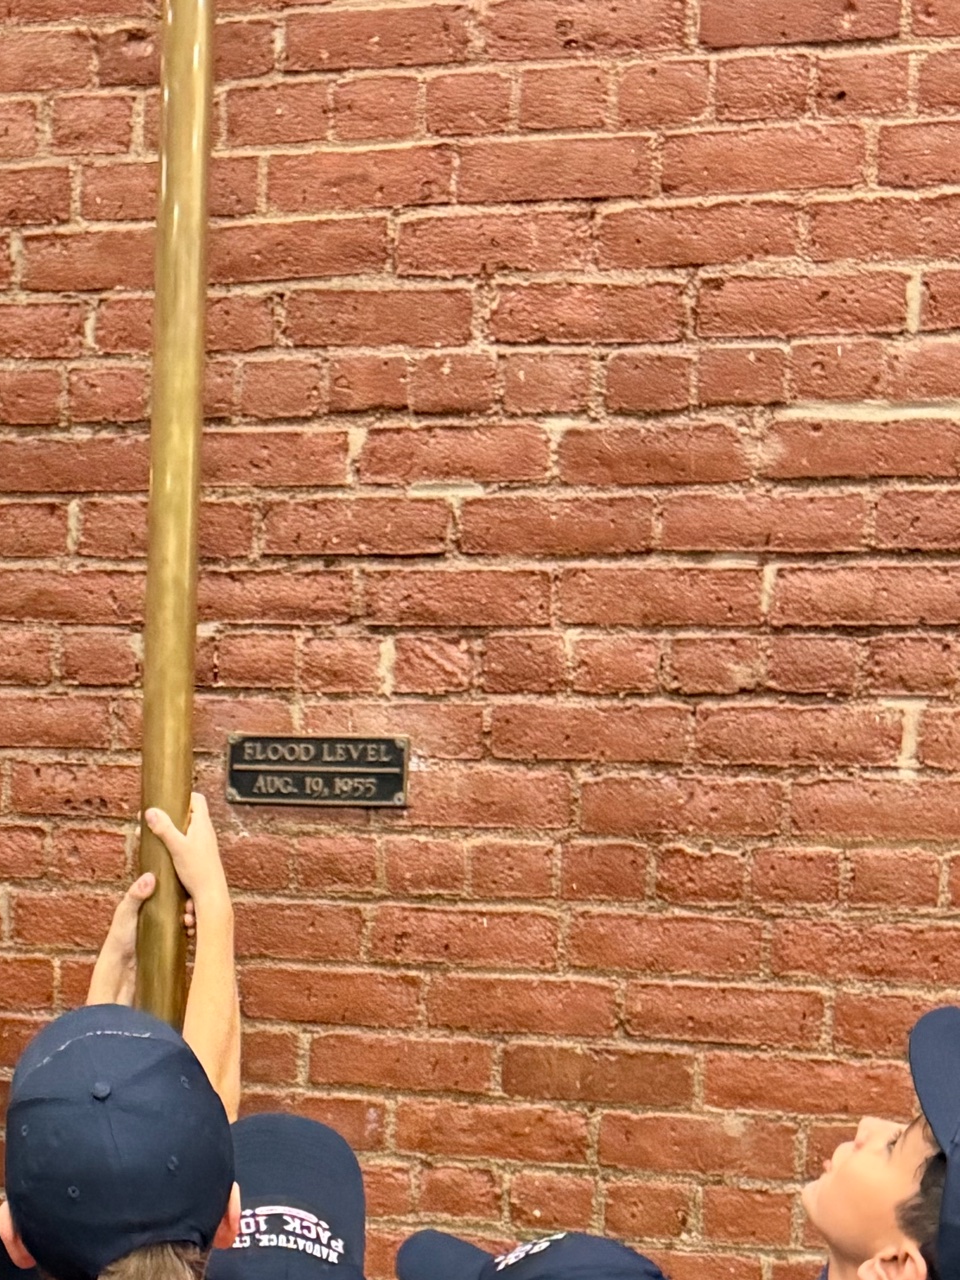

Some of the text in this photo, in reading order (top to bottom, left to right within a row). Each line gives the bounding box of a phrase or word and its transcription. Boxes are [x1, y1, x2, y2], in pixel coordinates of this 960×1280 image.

[243, 741, 391, 763] FLOOD LEVEL
[252, 774, 378, 798] AUG. 19, 1955
[240, 1216, 268, 1234] 10
[282, 1215, 344, 1255] PACK
